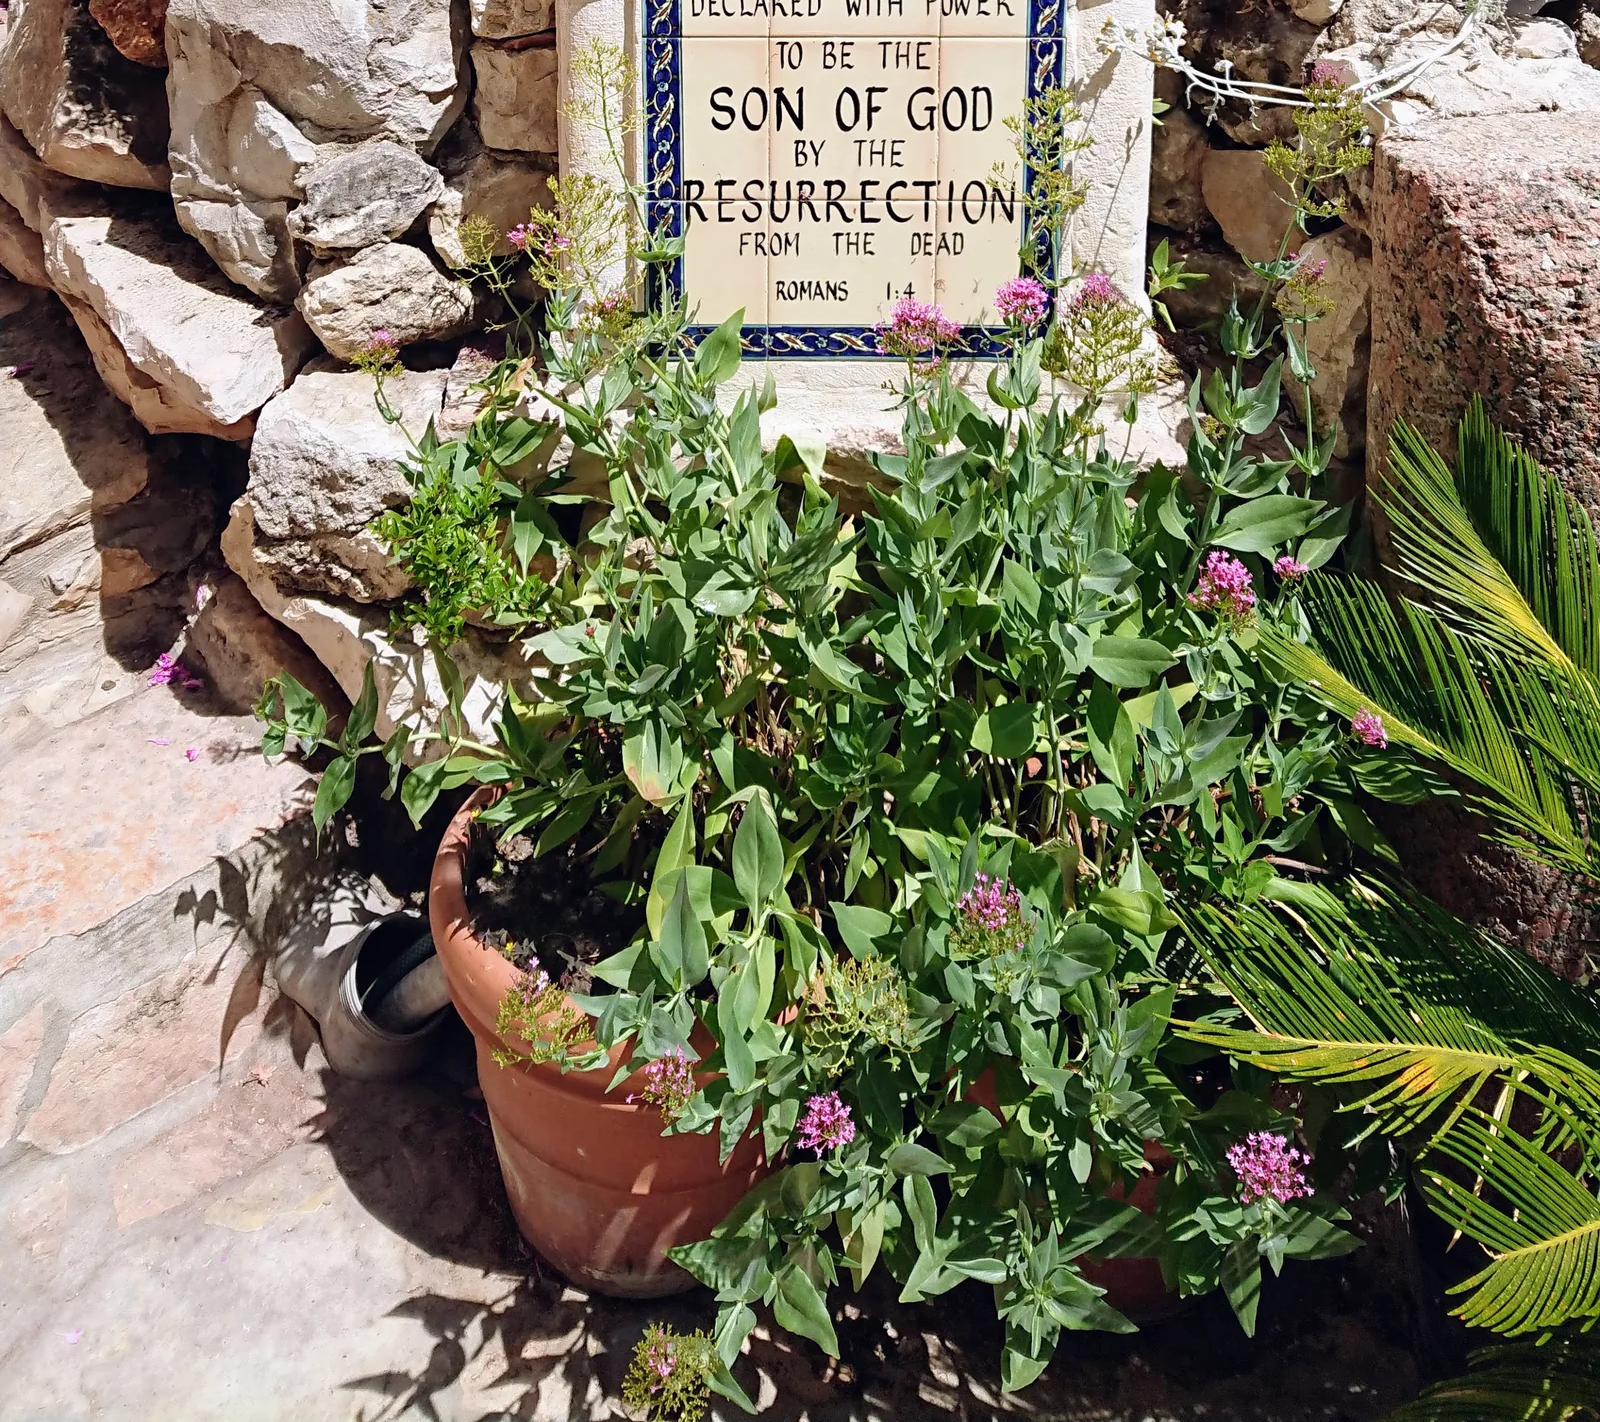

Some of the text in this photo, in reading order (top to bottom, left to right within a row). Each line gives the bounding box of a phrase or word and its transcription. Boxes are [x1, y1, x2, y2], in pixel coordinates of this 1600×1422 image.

[775, 40, 932, 71] TO BE THE
[709, 85, 993, 133] SON OF GOD
[793, 139, 906, 168] BY THE
[683, 178, 1015, 226] RESURRECTION
[738, 231, 965, 258] FROM THE DEAD
[775, 279, 916, 302] ROMANS 1:4
